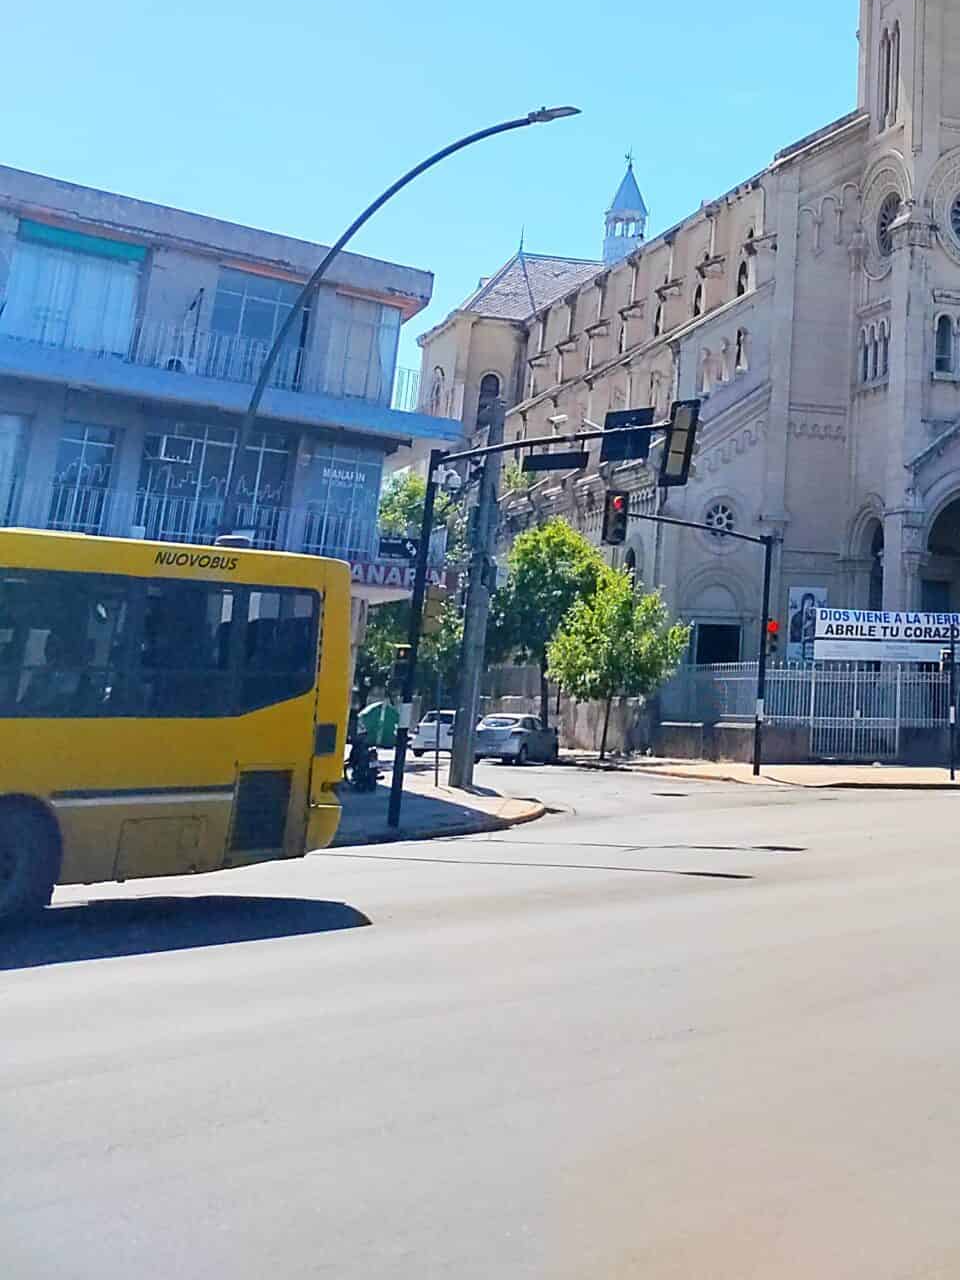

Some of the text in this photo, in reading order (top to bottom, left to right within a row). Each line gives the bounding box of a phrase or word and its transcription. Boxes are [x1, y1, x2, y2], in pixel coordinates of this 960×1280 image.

[154, 551, 240, 570] NUOVOBUS
[820, 610, 850, 622] DIOS
[853, 611, 891, 624] VIENE
[894, 613, 903, 624] A
[905, 614, 922, 625] LA
[824, 624, 877, 637] ABRILE
[881, 625, 900, 638] TU
